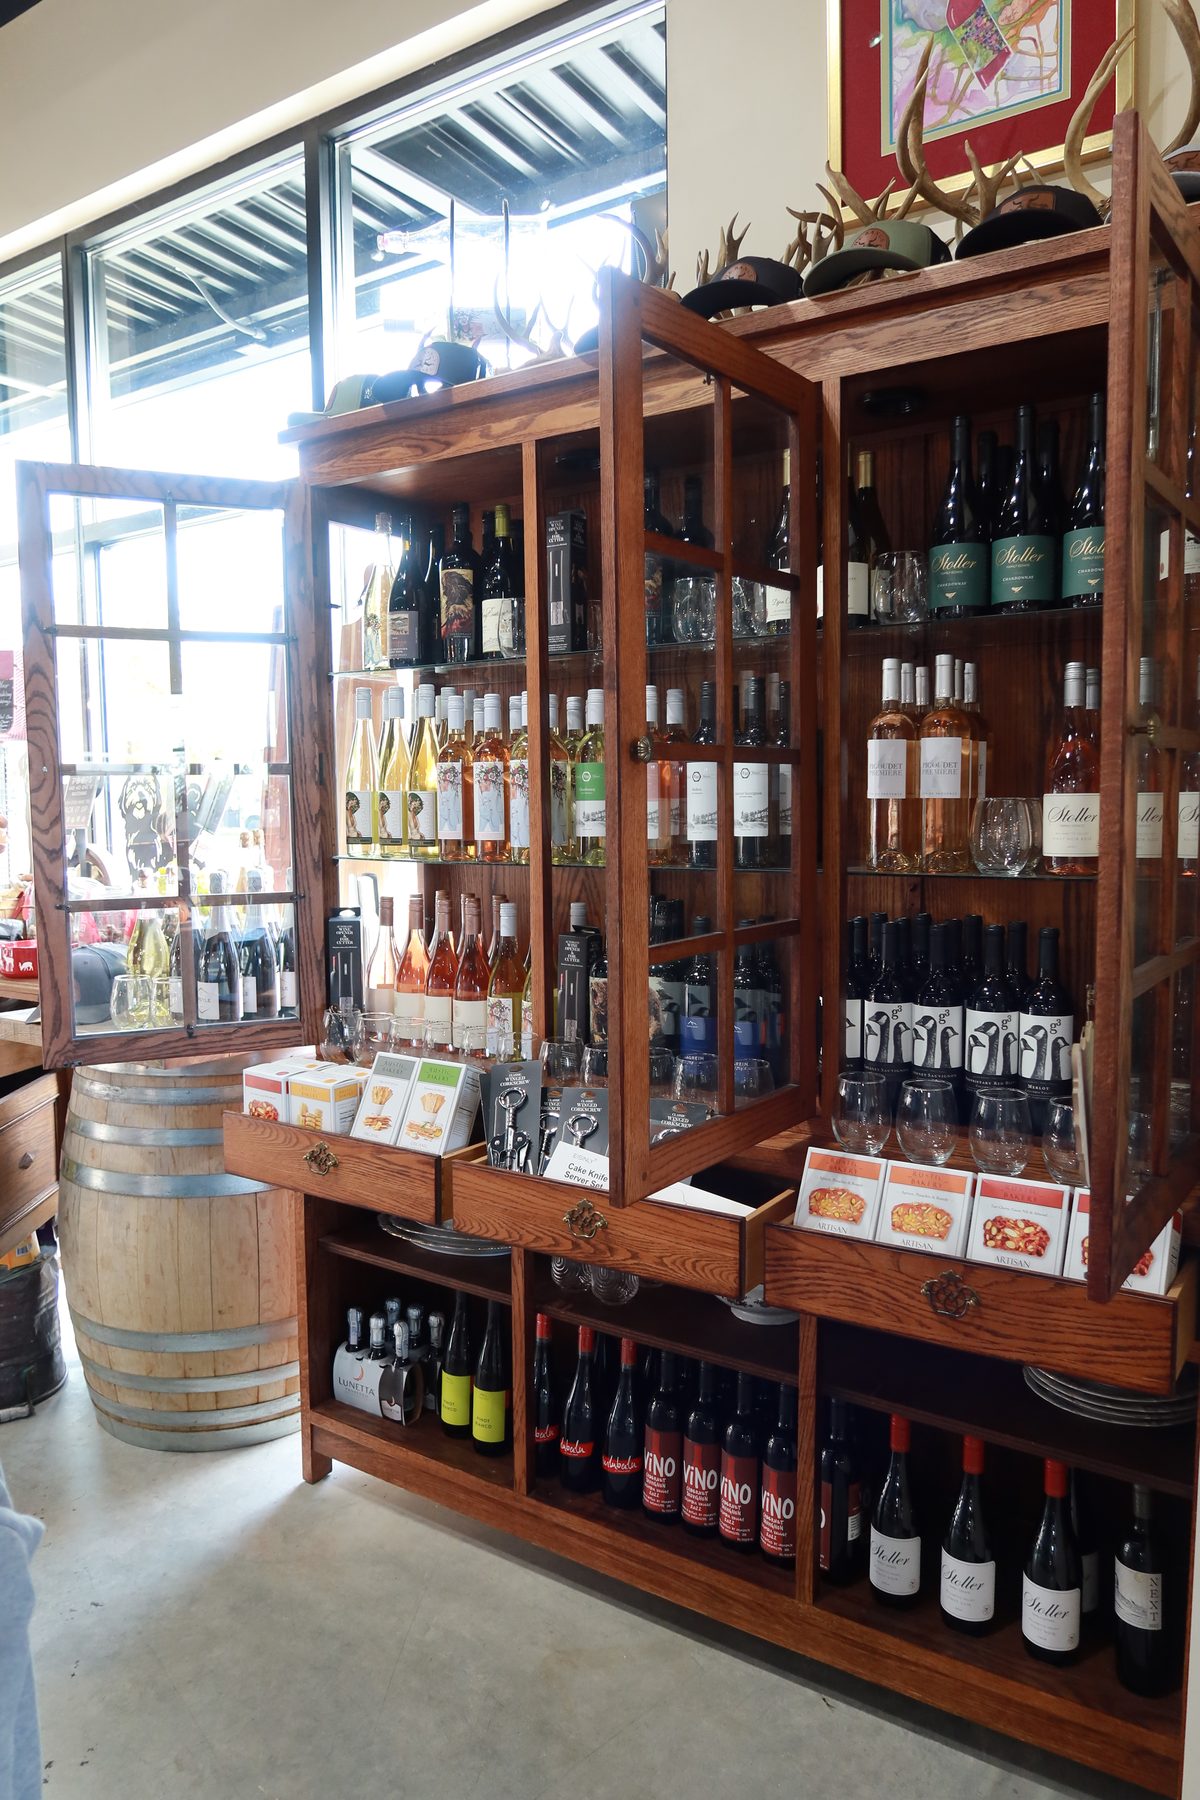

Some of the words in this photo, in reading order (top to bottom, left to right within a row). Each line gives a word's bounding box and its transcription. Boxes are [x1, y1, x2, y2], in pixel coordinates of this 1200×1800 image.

[931, 552, 977, 573] Stoller
[995, 545, 1046, 566] Stoller
[1048, 806, 1098, 823] Stoller
[660, 1120, 693, 1128] CORKSCREW
[564, 1170, 589, 1185] Server
[568, 1162, 587, 1175] Cake
[588, 1169, 608, 1182] Knife
[816, 1222, 847, 1234] ARTISAN
[902, 1239, 933, 1250] ARTISAN
[996, 1256, 1030, 1268] ARTISAN
[338, 1376, 375, 1396] LUNETTA
[872, 1541, 910, 1566] Stoller
[942, 1563, 985, 1590] Stoller
[1024, 1591, 1070, 1620] Stoller
[1150, 1577, 1159, 1622] NEXT
